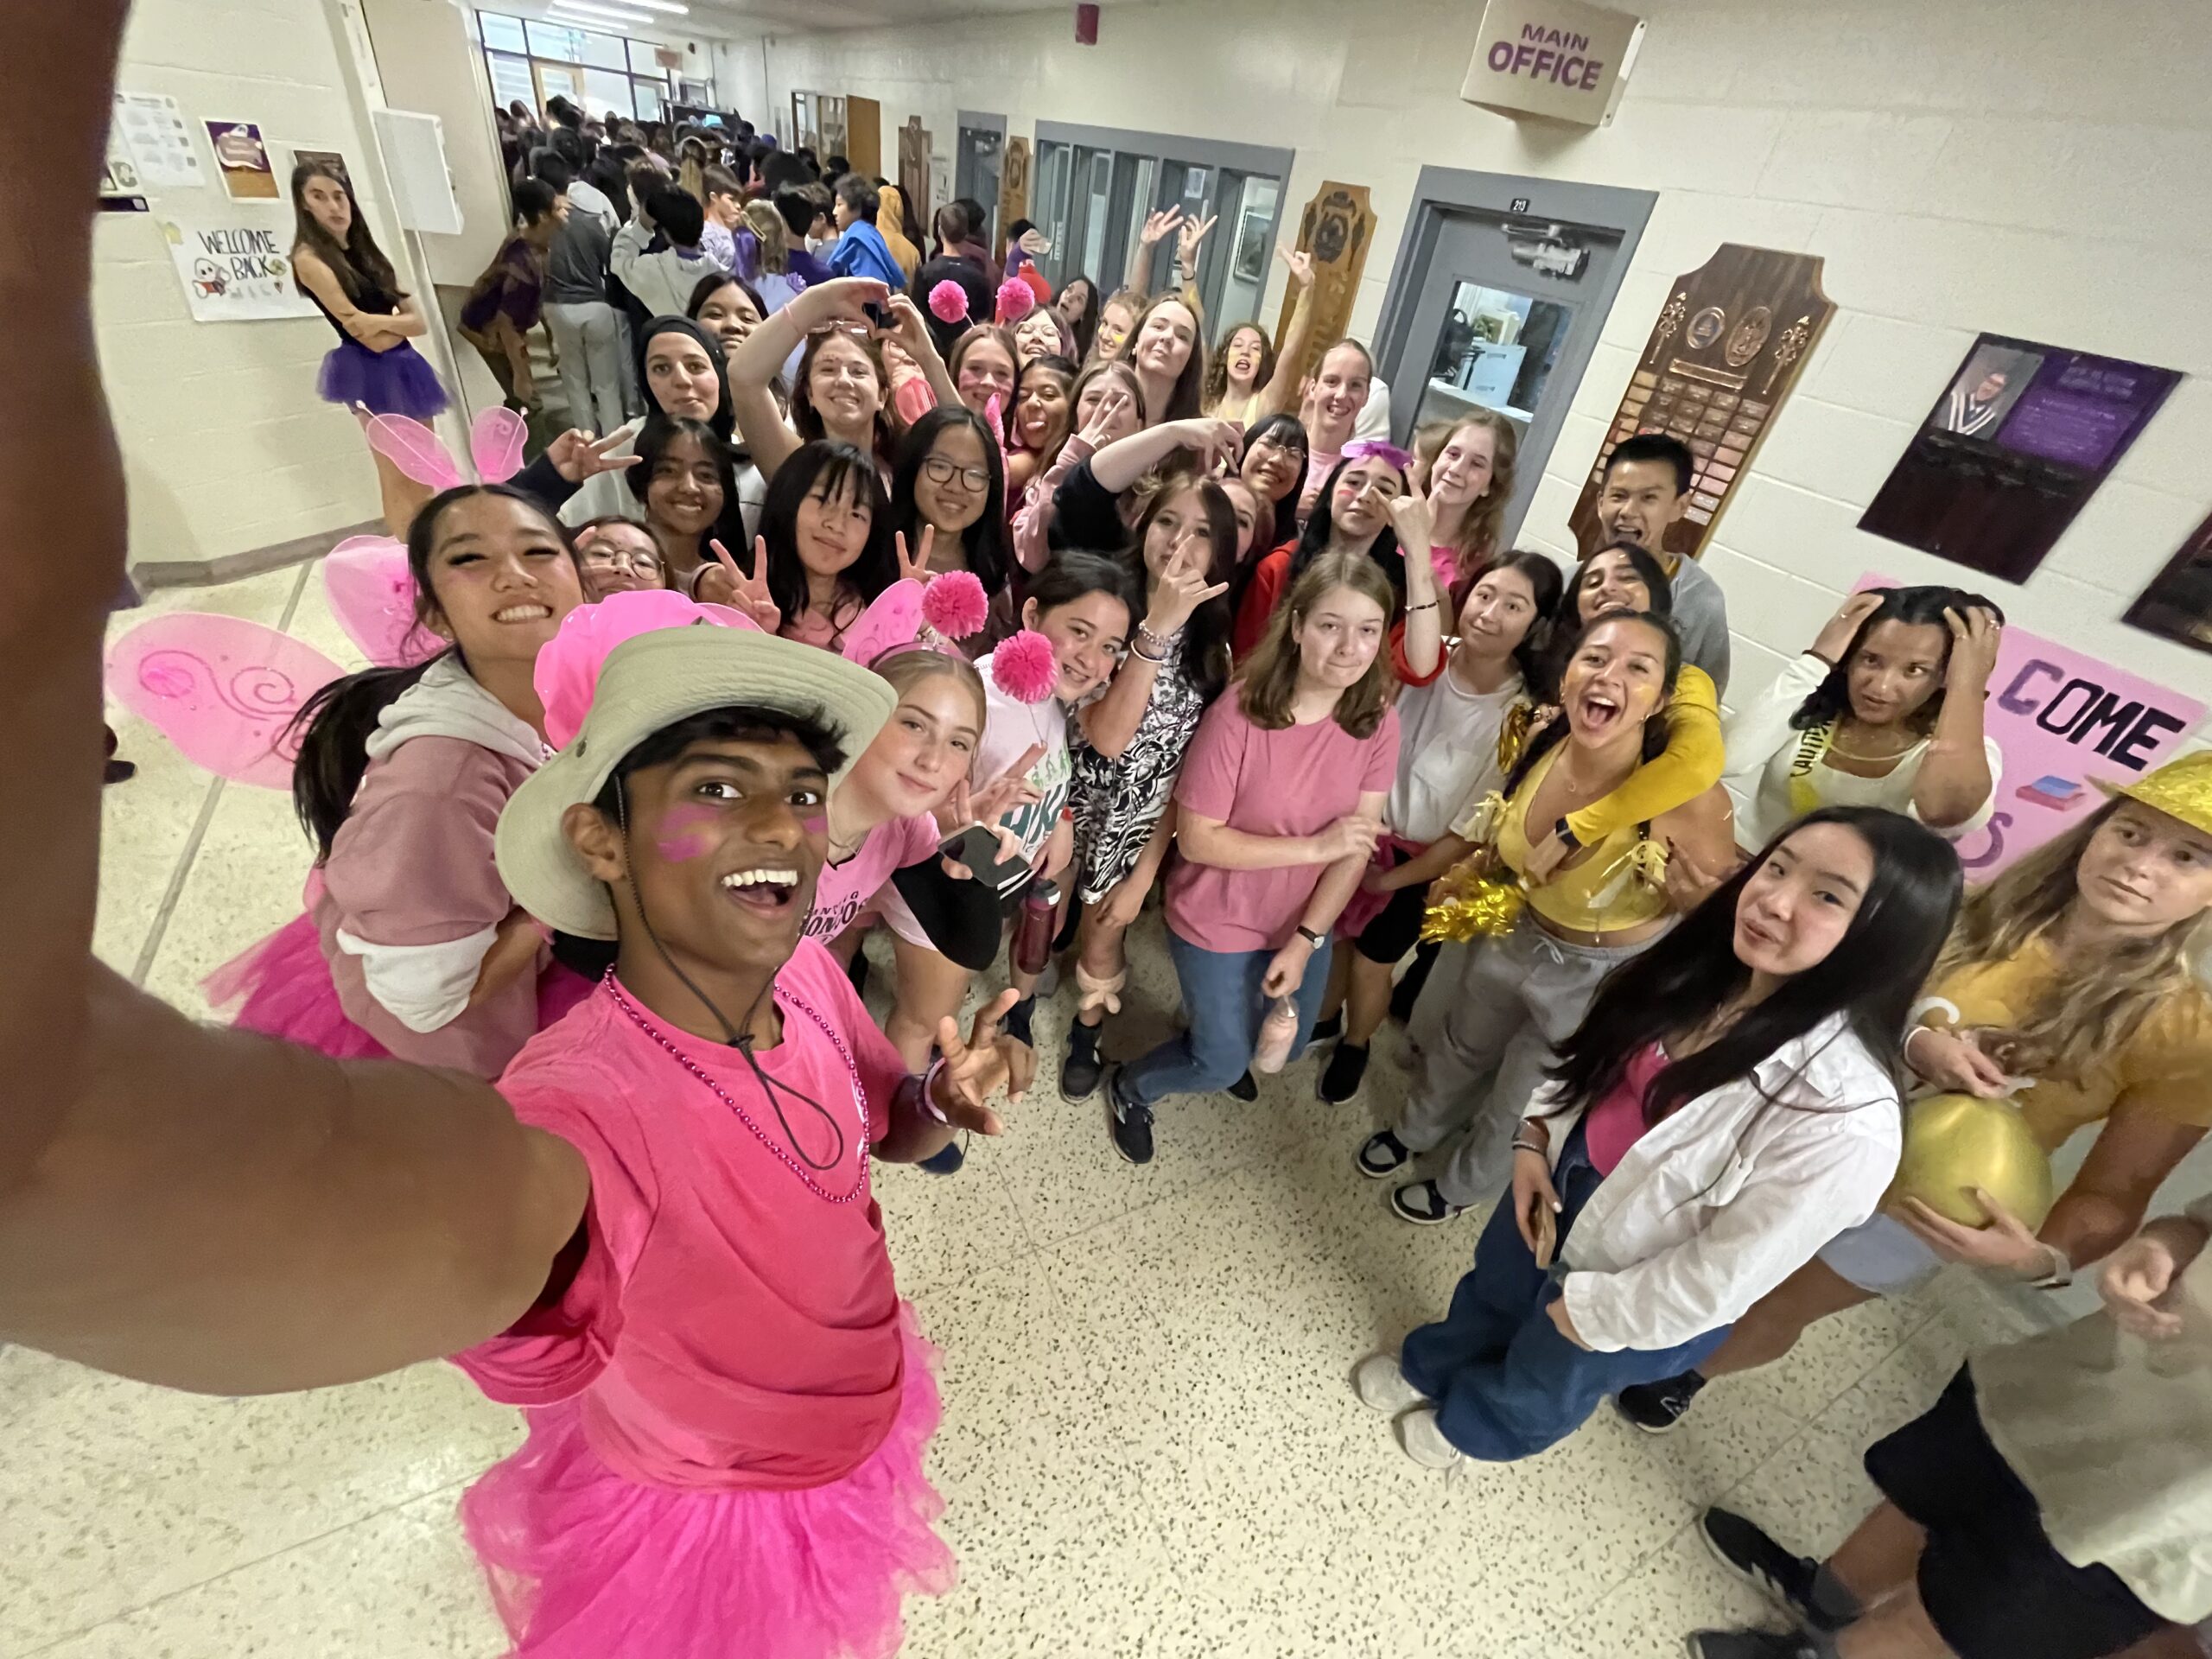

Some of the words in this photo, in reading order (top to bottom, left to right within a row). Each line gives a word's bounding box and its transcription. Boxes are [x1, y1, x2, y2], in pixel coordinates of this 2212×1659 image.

[1521, 23, 1590, 52] MAIN
[1488, 41, 1604, 91] OFFICE
[197, 229, 281, 255] WELCOME
[230, 255, 275, 281] BACK
[1985, 659, 2187, 772] COME
